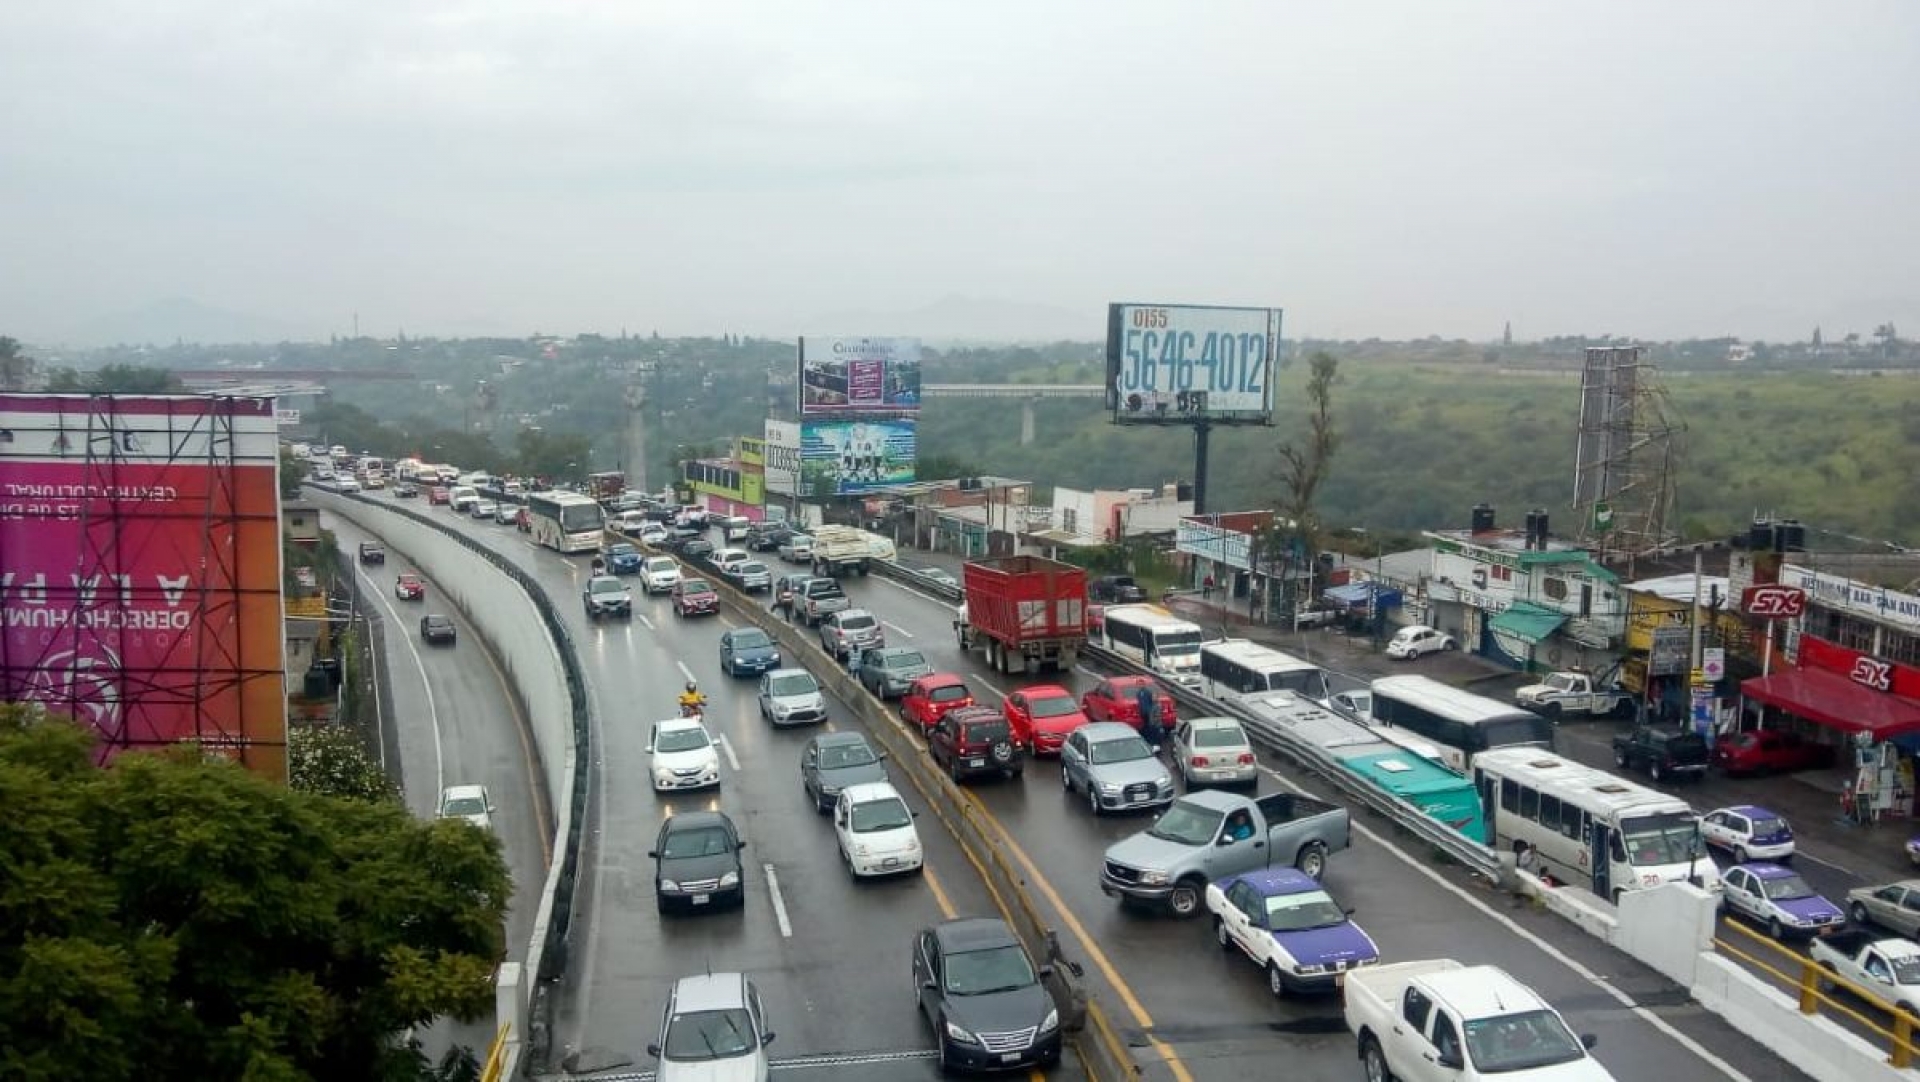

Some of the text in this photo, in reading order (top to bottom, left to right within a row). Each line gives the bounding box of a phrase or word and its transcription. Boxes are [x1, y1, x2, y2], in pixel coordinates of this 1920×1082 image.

[1134, 308, 1168, 328] 0155
[1125, 330, 1265, 392] 5646-4012
[72, 609, 190, 629] DERECHO
